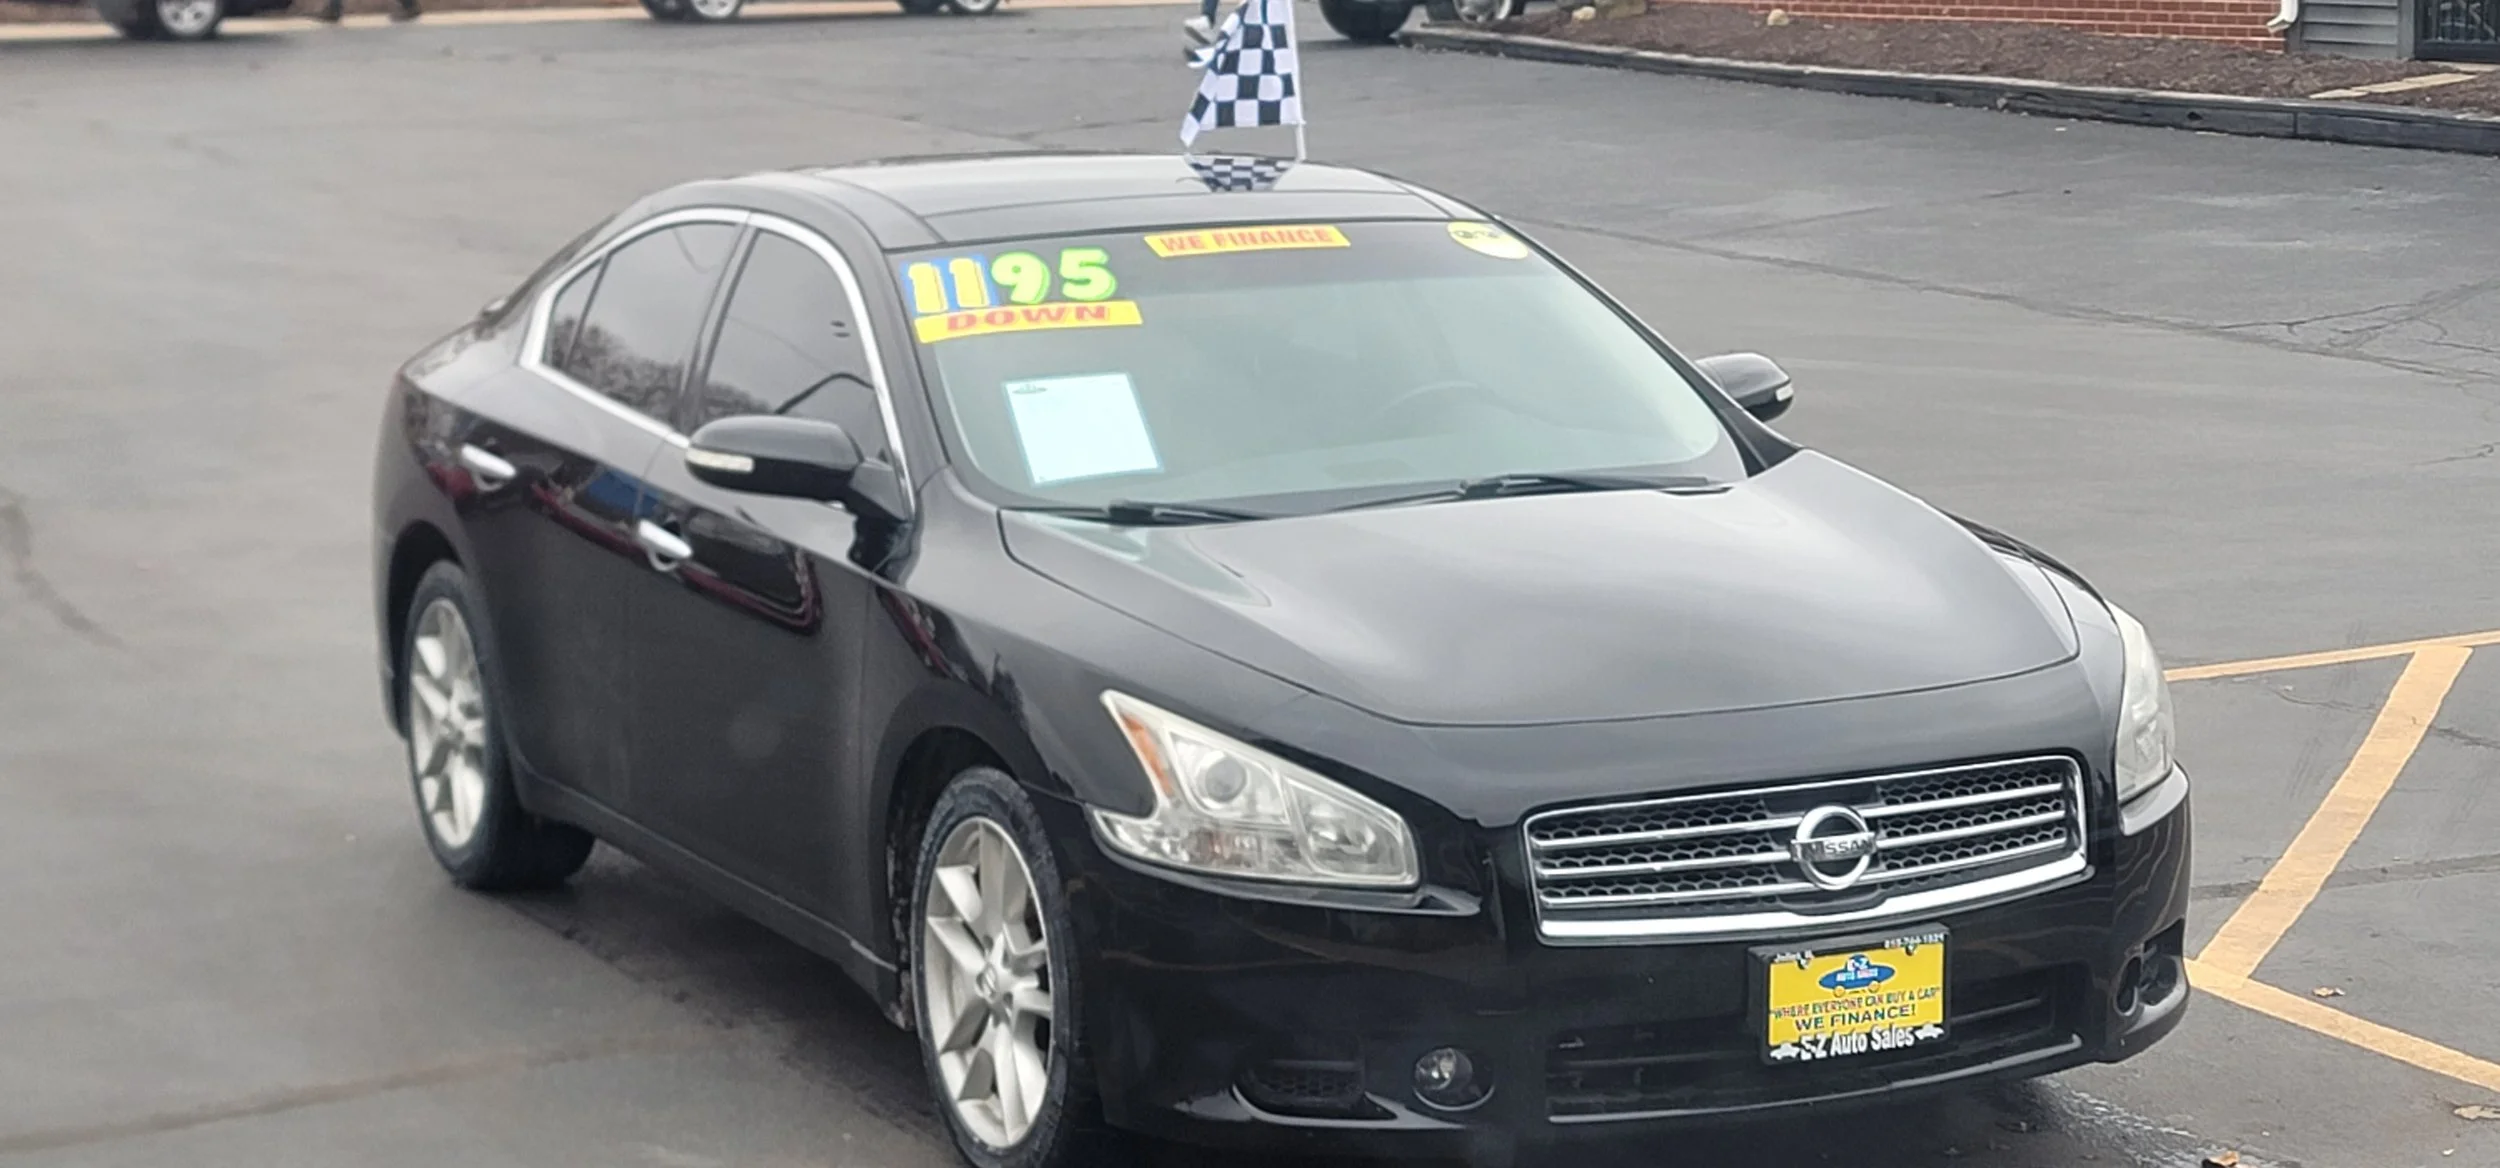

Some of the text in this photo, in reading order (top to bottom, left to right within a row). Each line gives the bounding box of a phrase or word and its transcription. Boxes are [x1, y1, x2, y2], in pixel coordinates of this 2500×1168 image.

[1160, 228, 1333, 251] WE FINANCE
[905, 247, 1117, 314] 1195
[946, 305, 1106, 331] DOWN
[1802, 839, 1872, 859] NISSAN
[1812, 997, 1862, 1015] EVERYONE
[1865, 993, 1884, 1008] CAN
[1886, 991, 1906, 1004] BUY
[1909, 990, 1915, 1001] A
[1795, 1004, 1916, 1031] WE FINANCE!
[1801, 1024, 1914, 1061] E-Z Auto Sales
